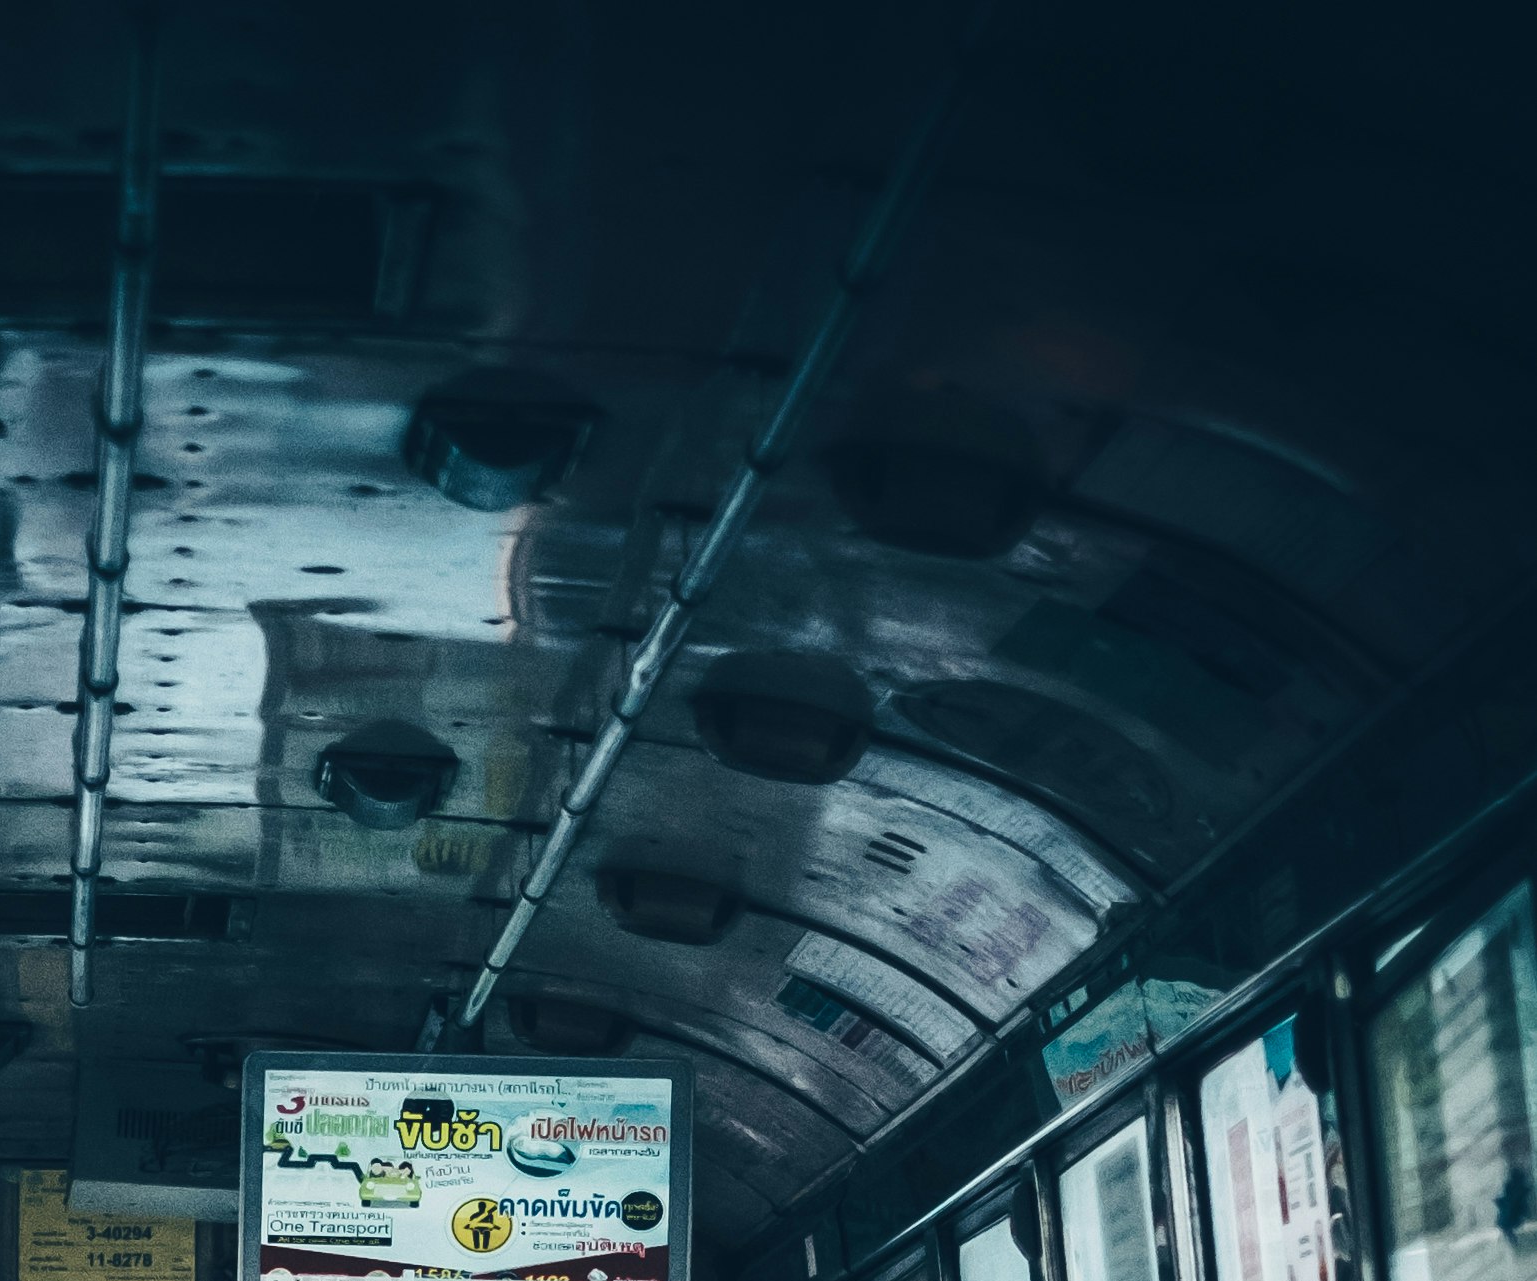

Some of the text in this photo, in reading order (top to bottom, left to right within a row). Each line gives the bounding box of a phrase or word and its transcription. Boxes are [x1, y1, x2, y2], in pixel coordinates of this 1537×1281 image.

[394, 1109, 503, 1152] ขับช้า
[530, 1116, 668, 1143] เปิดไฟหน้ารถ
[499, 1188, 622, 1219] คาดเข็มขัด
[269, 1219, 389, 1237] One Transport
